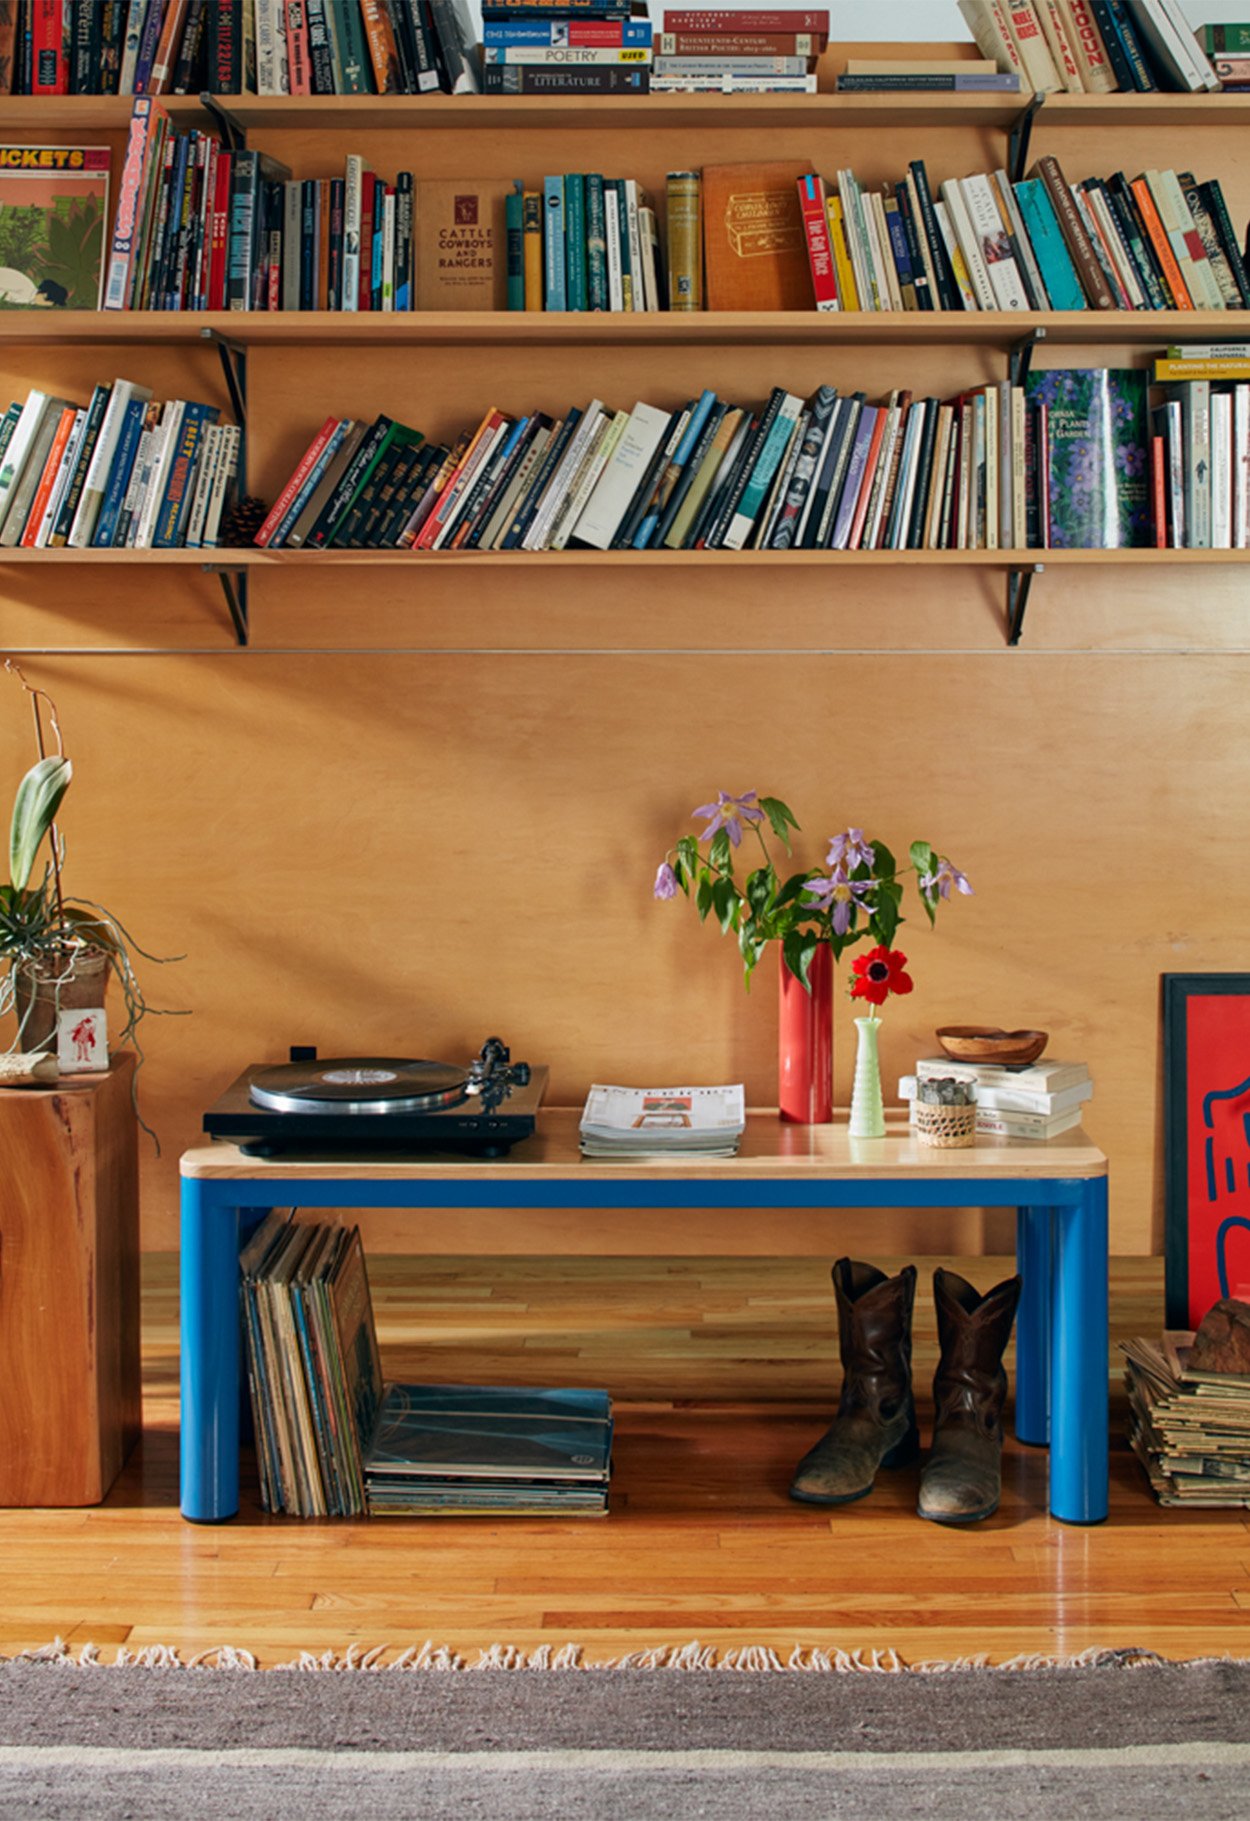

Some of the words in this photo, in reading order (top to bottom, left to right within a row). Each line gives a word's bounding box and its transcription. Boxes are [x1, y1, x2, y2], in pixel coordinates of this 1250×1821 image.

[217, 25, 233, 81] 11/22/63
[545, 50, 598, 62] POETRY
[534, 77, 600, 87] LITERATURE
[1045, 160, 1058, 177] THE
[230, 193, 251, 233] BLACK
[439, 229, 493, 238] CATTLE
[808, 219, 825, 236] The
[438, 239, 493, 250] COWBOYS
[811, 236, 828, 255] Gay
[438, 259, 492, 268] RANGERS
[815, 253, 830, 276] Place
[181, 425, 197, 458] BEST
[373, 422, 389, 441] The
[1024, 412, 1033, 467] PARADISE
[358, 438, 380, 467] Master
[290, 464, 308, 486] BOOK
[348, 466, 364, 485] and
[1024, 470, 1033, 500] LOST
[323, 480, 355, 527] Margarita
[163, 501, 180, 540] READING
